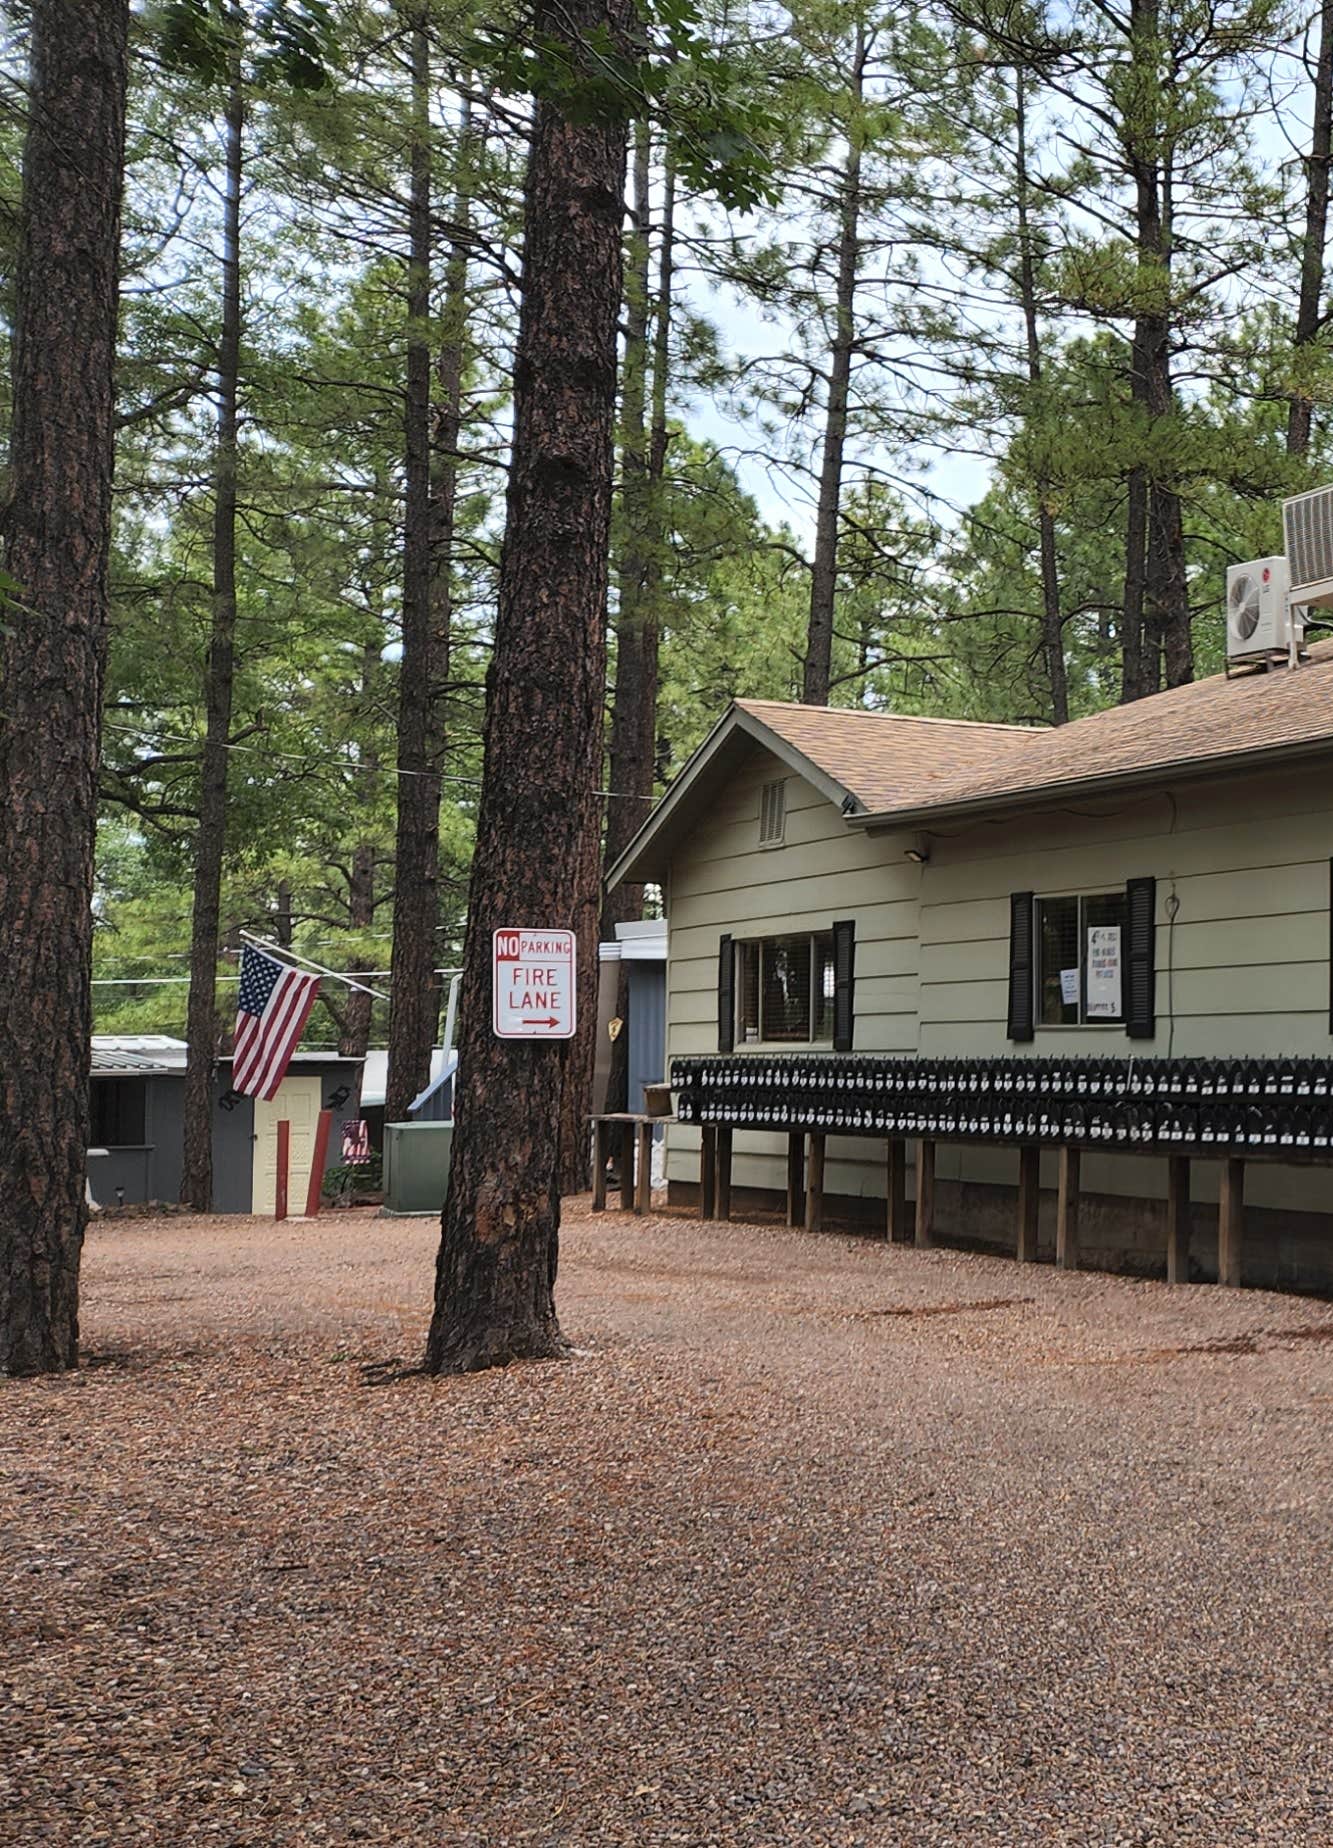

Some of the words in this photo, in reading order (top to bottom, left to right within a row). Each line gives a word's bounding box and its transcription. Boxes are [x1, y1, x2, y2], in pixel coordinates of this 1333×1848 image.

[497, 936, 519, 957] NO
[521, 941, 571, 954] PARKING
[513, 968, 558, 986] FIRE
[509, 991, 561, 1009] LANE
